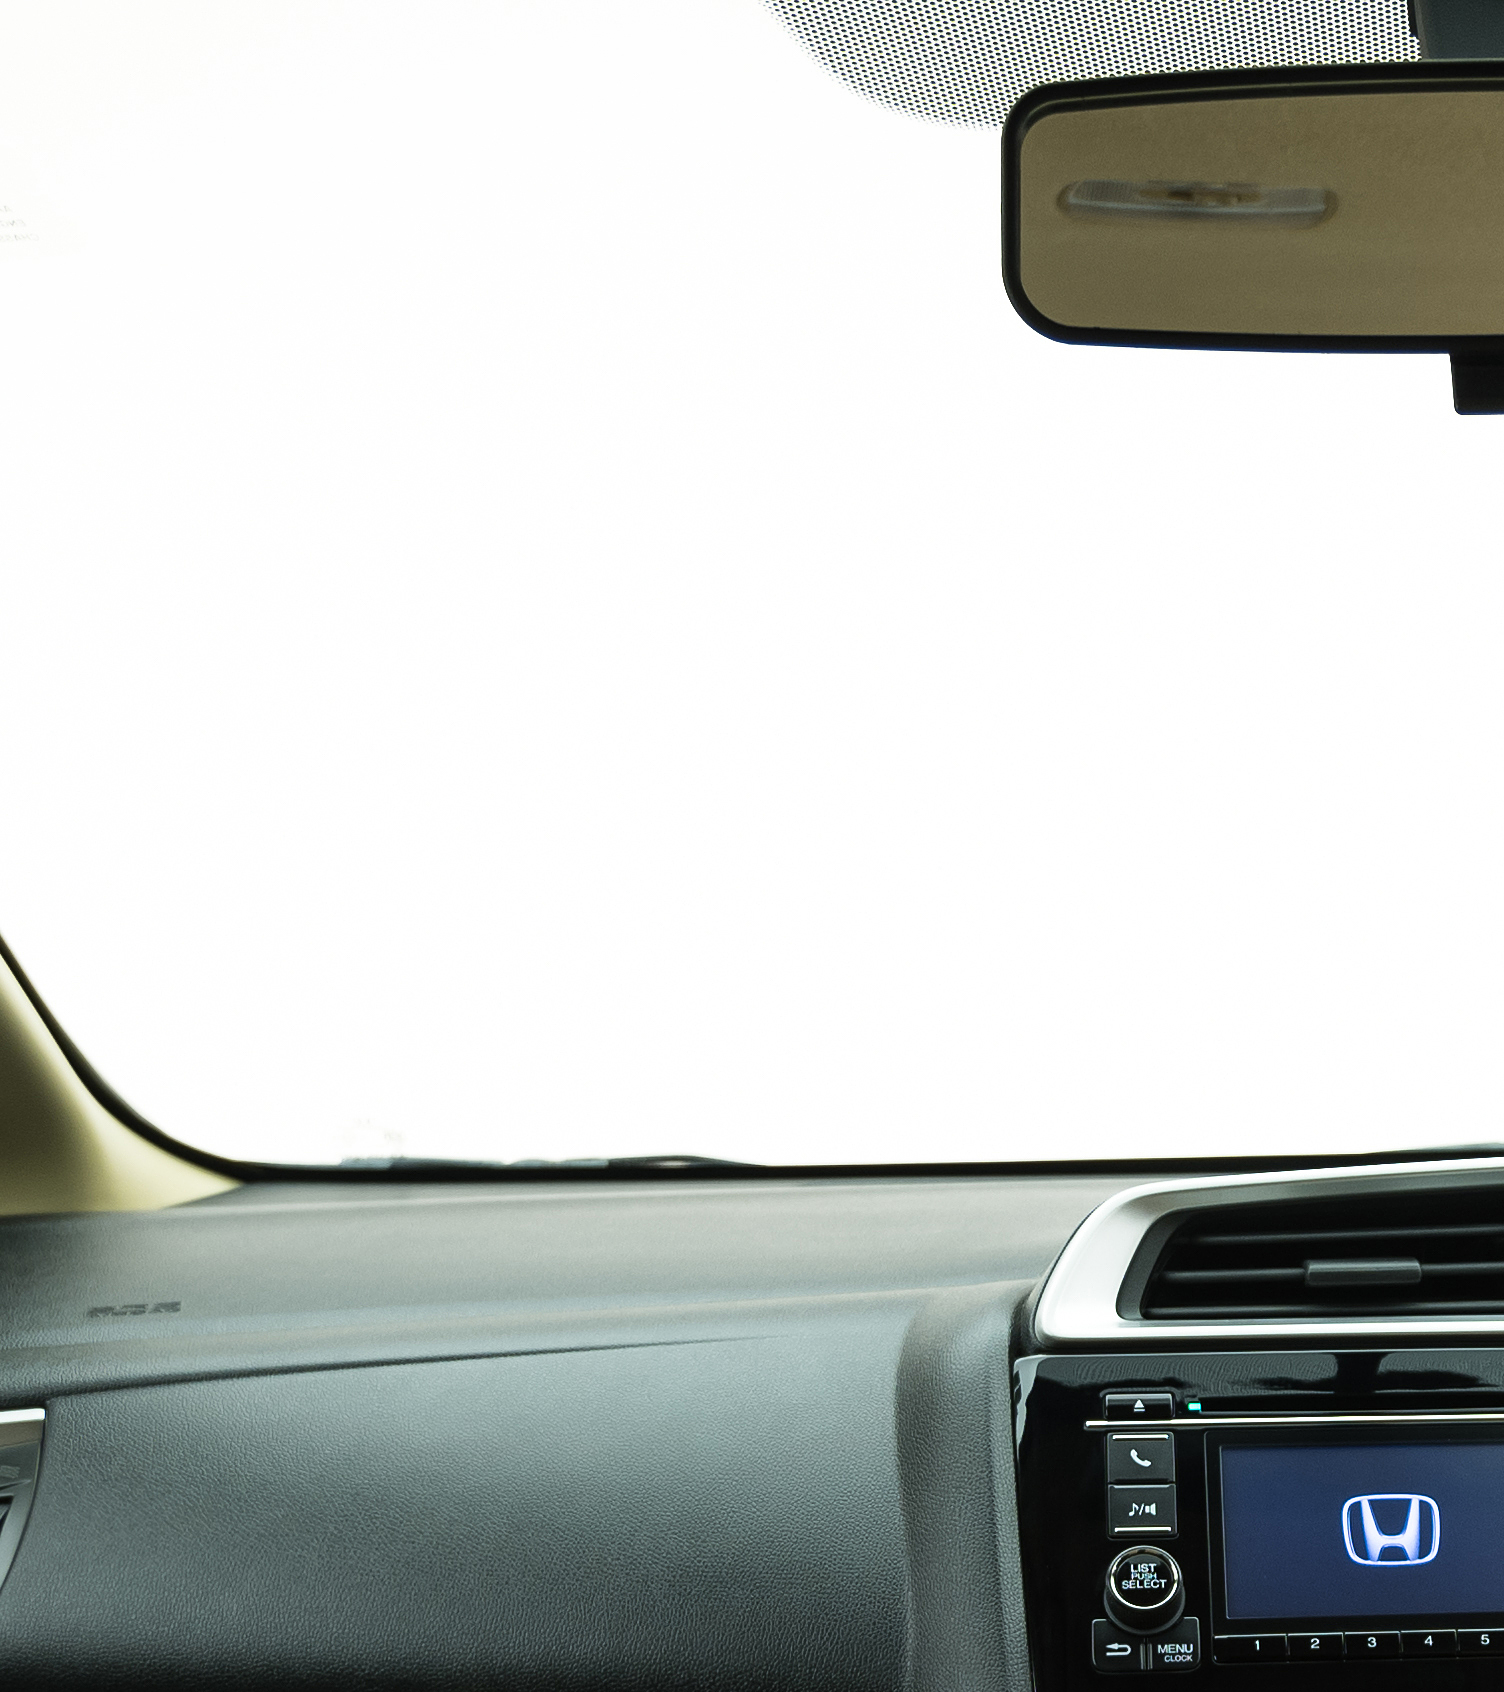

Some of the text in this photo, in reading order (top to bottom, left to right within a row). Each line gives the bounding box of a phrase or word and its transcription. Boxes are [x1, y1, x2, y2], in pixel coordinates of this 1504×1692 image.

[1130, 1562, 1157, 1573] LIST
[1121, 1579, 1167, 1590] SELECT
[1310, 1638, 1320, 1649] 2
[1367, 1637, 1377, 1648] 3
[1423, 1635, 1434, 1646] 4
[1480, 1634, 1490, 1645] 5
[1157, 1644, 1194, 1654] MENU
[1164, 1654, 1193, 1663] CLOCK
